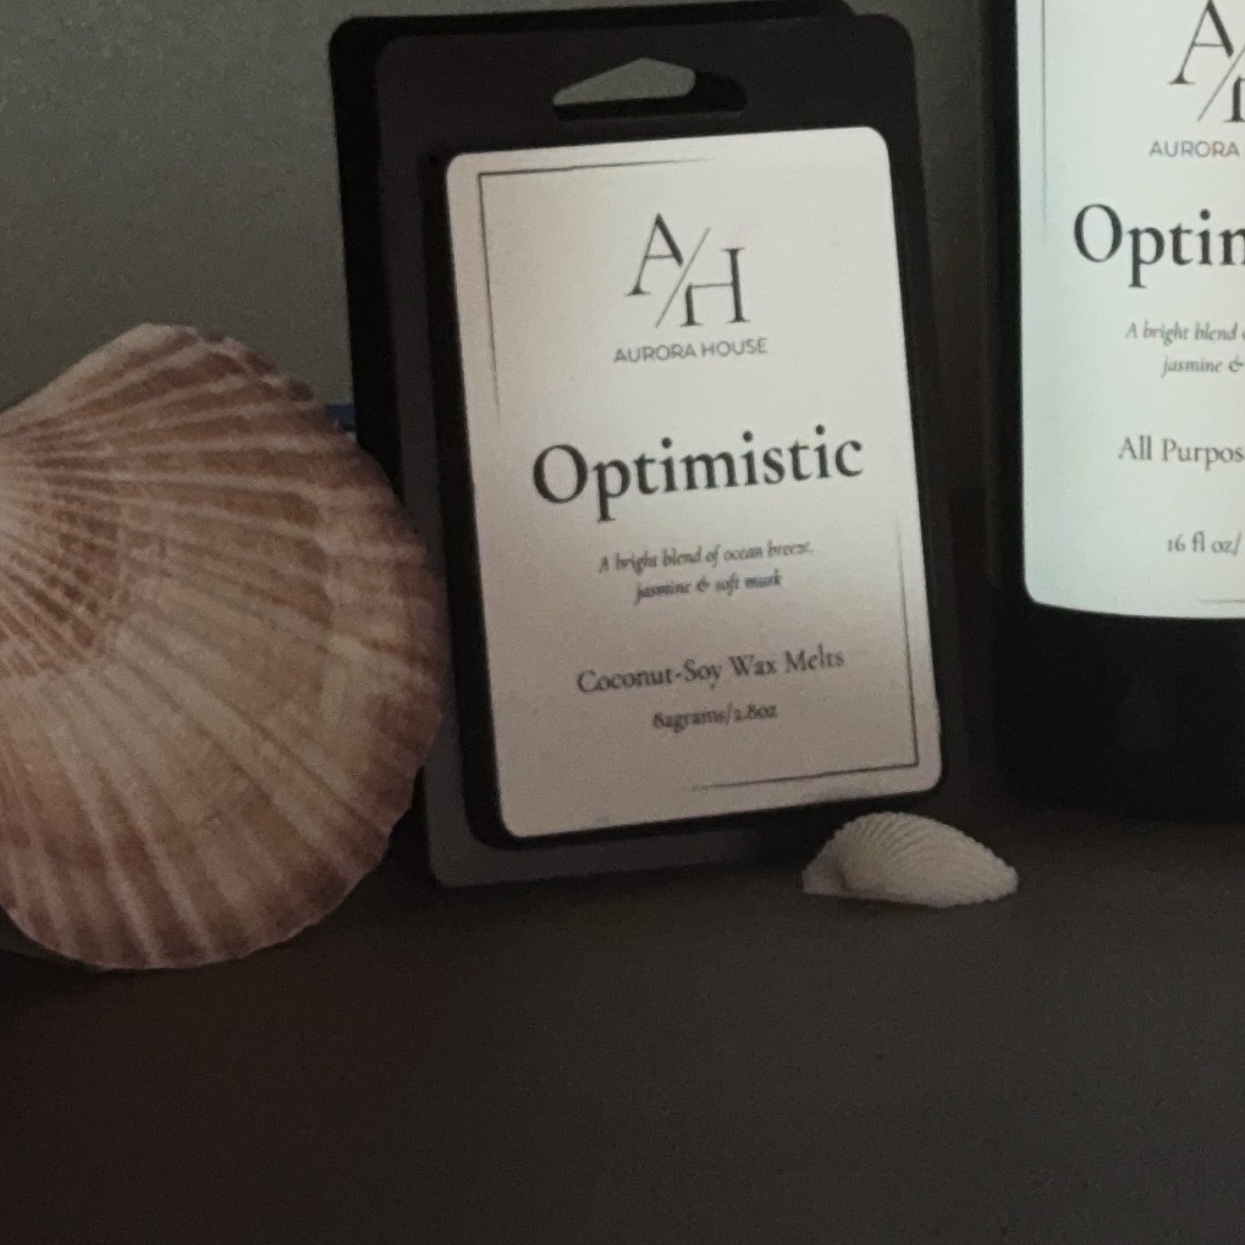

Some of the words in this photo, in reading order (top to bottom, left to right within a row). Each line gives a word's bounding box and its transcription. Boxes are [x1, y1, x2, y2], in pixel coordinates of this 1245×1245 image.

[1149, 140, 1240, 157] AURORA
[1125, 323, 1138, 339] A
[1143, 320, 1189, 346] bright
[1194, 322, 1238, 341] blend
[614, 343, 696, 363] AURORA
[702, 338, 768, 357] HOUSE
[1161, 356, 1222, 378] jasmine
[1229, 358, 1244, 373] &
[1118, 435, 1152, 461] All
[533, 424, 864, 522] Optimistic
[1167, 533, 1186, 553] 16
[1193, 531, 1205, 553] fl
[599, 556, 610, 572] A
[616, 551, 657, 575] bright
[662, 545, 702, 567] blend
[706, 543, 721, 568] of
[725, 546, 763, 560] ocean
[634, 582, 691, 603] jasmine
[697, 575, 709, 592] &
[715, 572, 739, 595] soft
[745, 568, 782, 587] musk
[577, 657, 722, 693] Coconut-Soy
[729, 654, 777, 675] Wax
[784, 644, 845, 672] Melts
